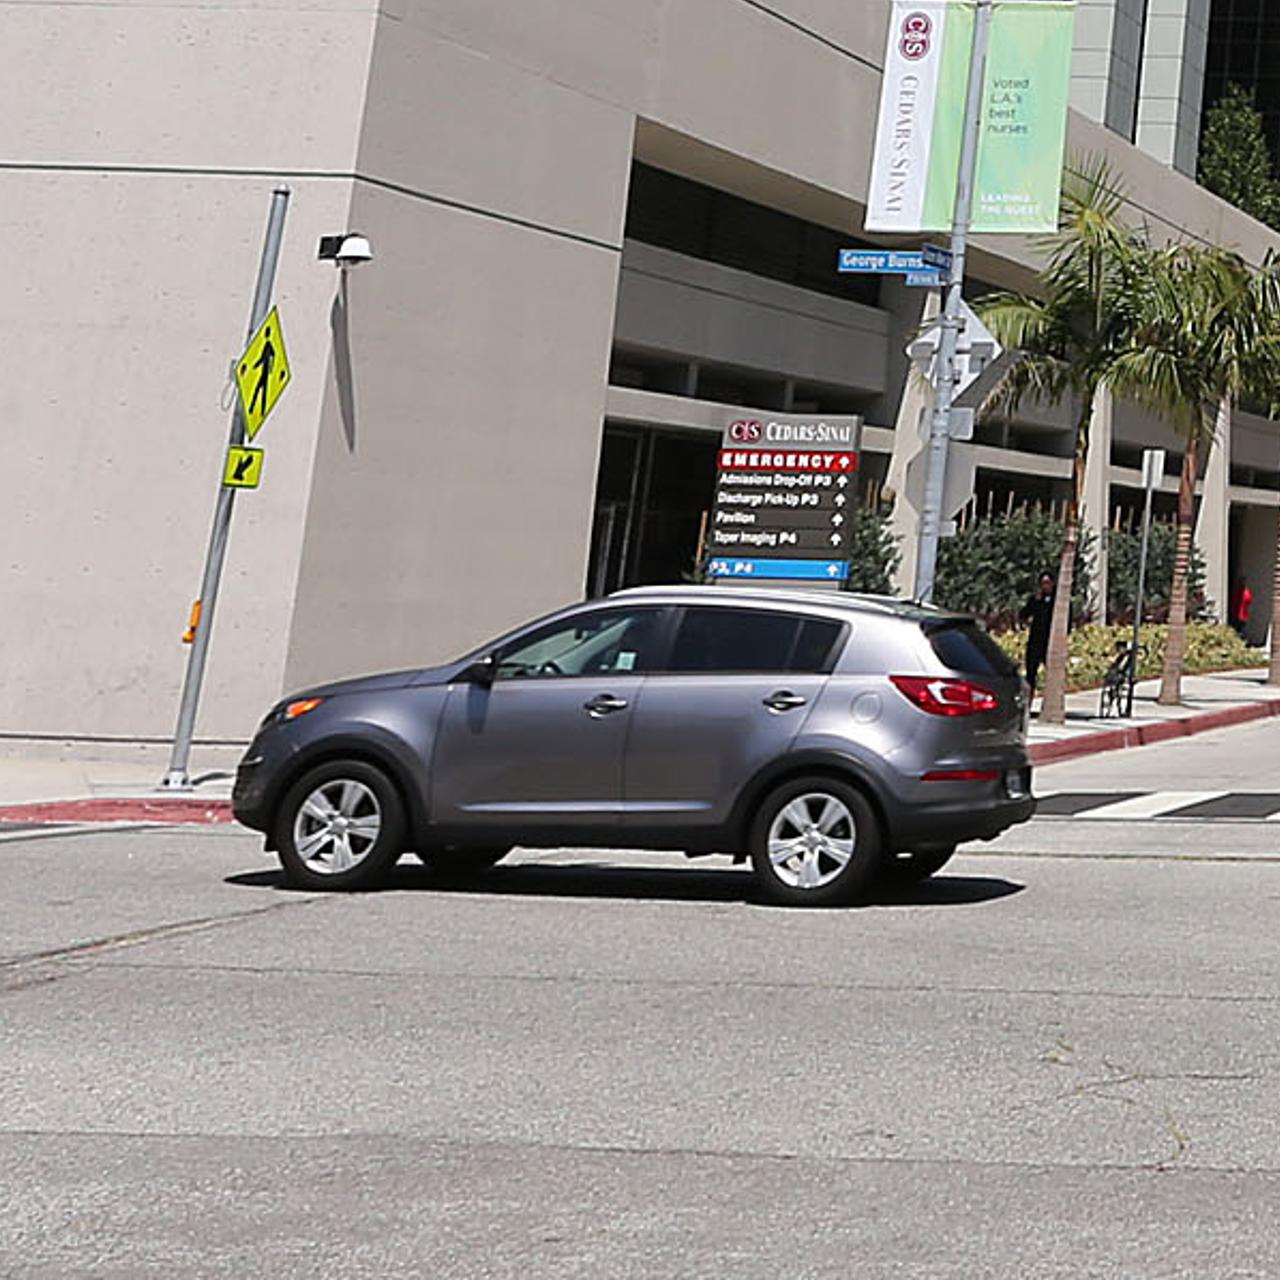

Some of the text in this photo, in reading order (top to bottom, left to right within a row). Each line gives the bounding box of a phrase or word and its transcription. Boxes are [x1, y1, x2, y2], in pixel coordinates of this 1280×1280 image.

[992, 78, 1030, 89] Voted
[989, 107, 1016, 119] best
[987, 124, 1028, 134] nurses
[843, 253, 885, 269] George
[888, 254, 923, 268] Burns
[721, 452, 834, 469] EMERGENCY
[719, 473, 832, 488] Admissions Drop-Off P3
[717, 491, 819, 507] Discharge Pick-Up P3
[715, 511, 756, 524] Pavilion
[741, 531, 777, 547] Imaging
[779, 532, 797, 545] P4
